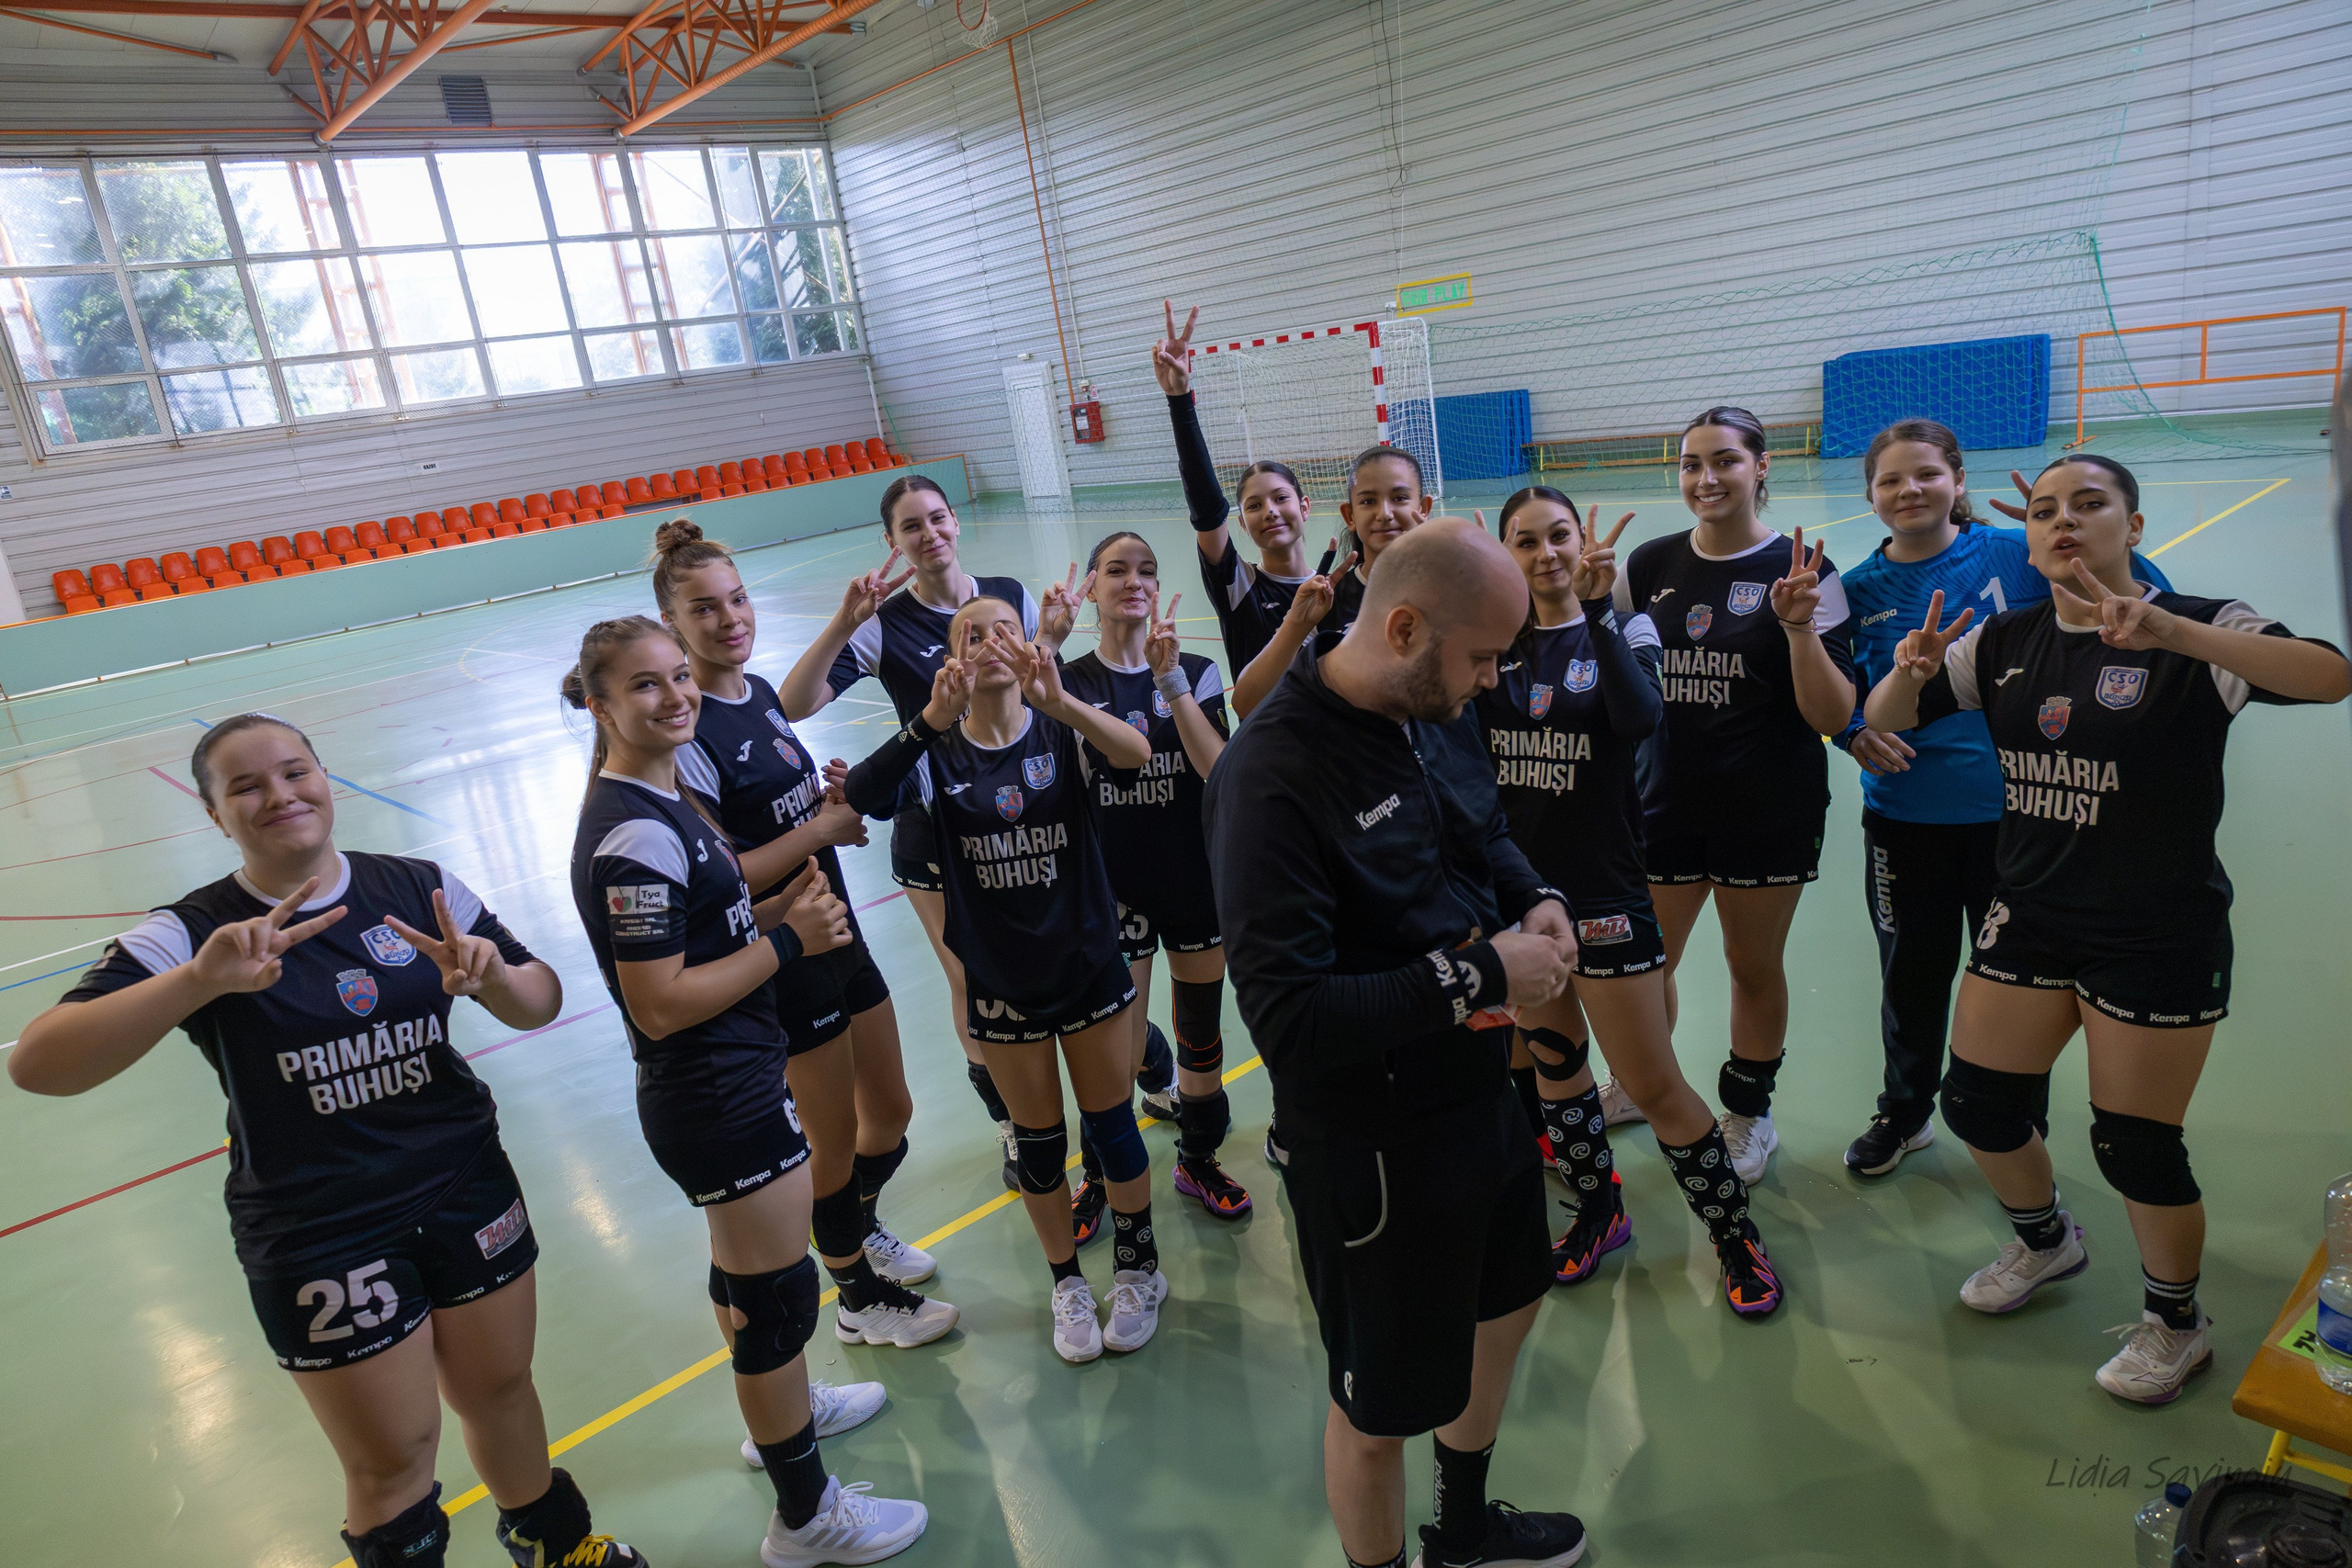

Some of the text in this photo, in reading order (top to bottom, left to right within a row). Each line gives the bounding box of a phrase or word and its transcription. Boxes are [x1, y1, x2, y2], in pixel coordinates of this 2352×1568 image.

[1736, 587, 1760, 596] CSO
[1979, 576, 2008, 615] 1
[1860, 608, 1898, 627] Kempa
[1663, 646, 1746, 678] IMĂRIA
[2109, 671, 2139, 684] CSO
[1662, 678, 1731, 709] UHUȘI
[1490, 726, 1591, 761] PRIMĂRIA
[1497, 760, 1575, 796] BUHUȘI
[1354, 794, 1401, 830] Kempa
[2005, 783, 2100, 830] BUHUȘI
[959, 823, 1069, 861] PRIMĂRIA
[976, 854, 1058, 888] BUHUȘI
[1729, 876, 1758, 886] Kempa
[1767, 874, 1799, 884] Kempa
[636, 900, 663, 909] Fruct
[641, 890, 661, 900] Tya
[1873, 845, 1897, 933] Kempa
[1180, 942, 1204, 951] Kempa
[1585, 966, 1613, 976] Kempa
[1623, 961, 1651, 973] Kempa
[1979, 963, 2018, 981] Kempa
[2033, 976, 2075, 987] Kempa
[813, 1010, 841, 1029] Kempa
[1061, 1020, 1086, 1032] Kempa
[1091, 1001, 1119, 1021] Kempa
[2097, 997, 2134, 1018] Kempa
[2149, 1012, 2190, 1024] Kempa
[277, 1013, 443, 1082] PRIMĂRIA
[986, 1030, 1016, 1042] Kempa
[1023, 1030, 1048, 1041] Kempa
[308, 1051, 433, 1114] BUHUȘI
[1725, 1065, 1756, 1083] Kempa
[695, 1148, 808, 1204] Kempa Kempa Kempa
[296, 1258, 399, 1344] 25
[294, 1356, 332, 1369] Kempa
[346, 1336, 392, 1359] Kempa
